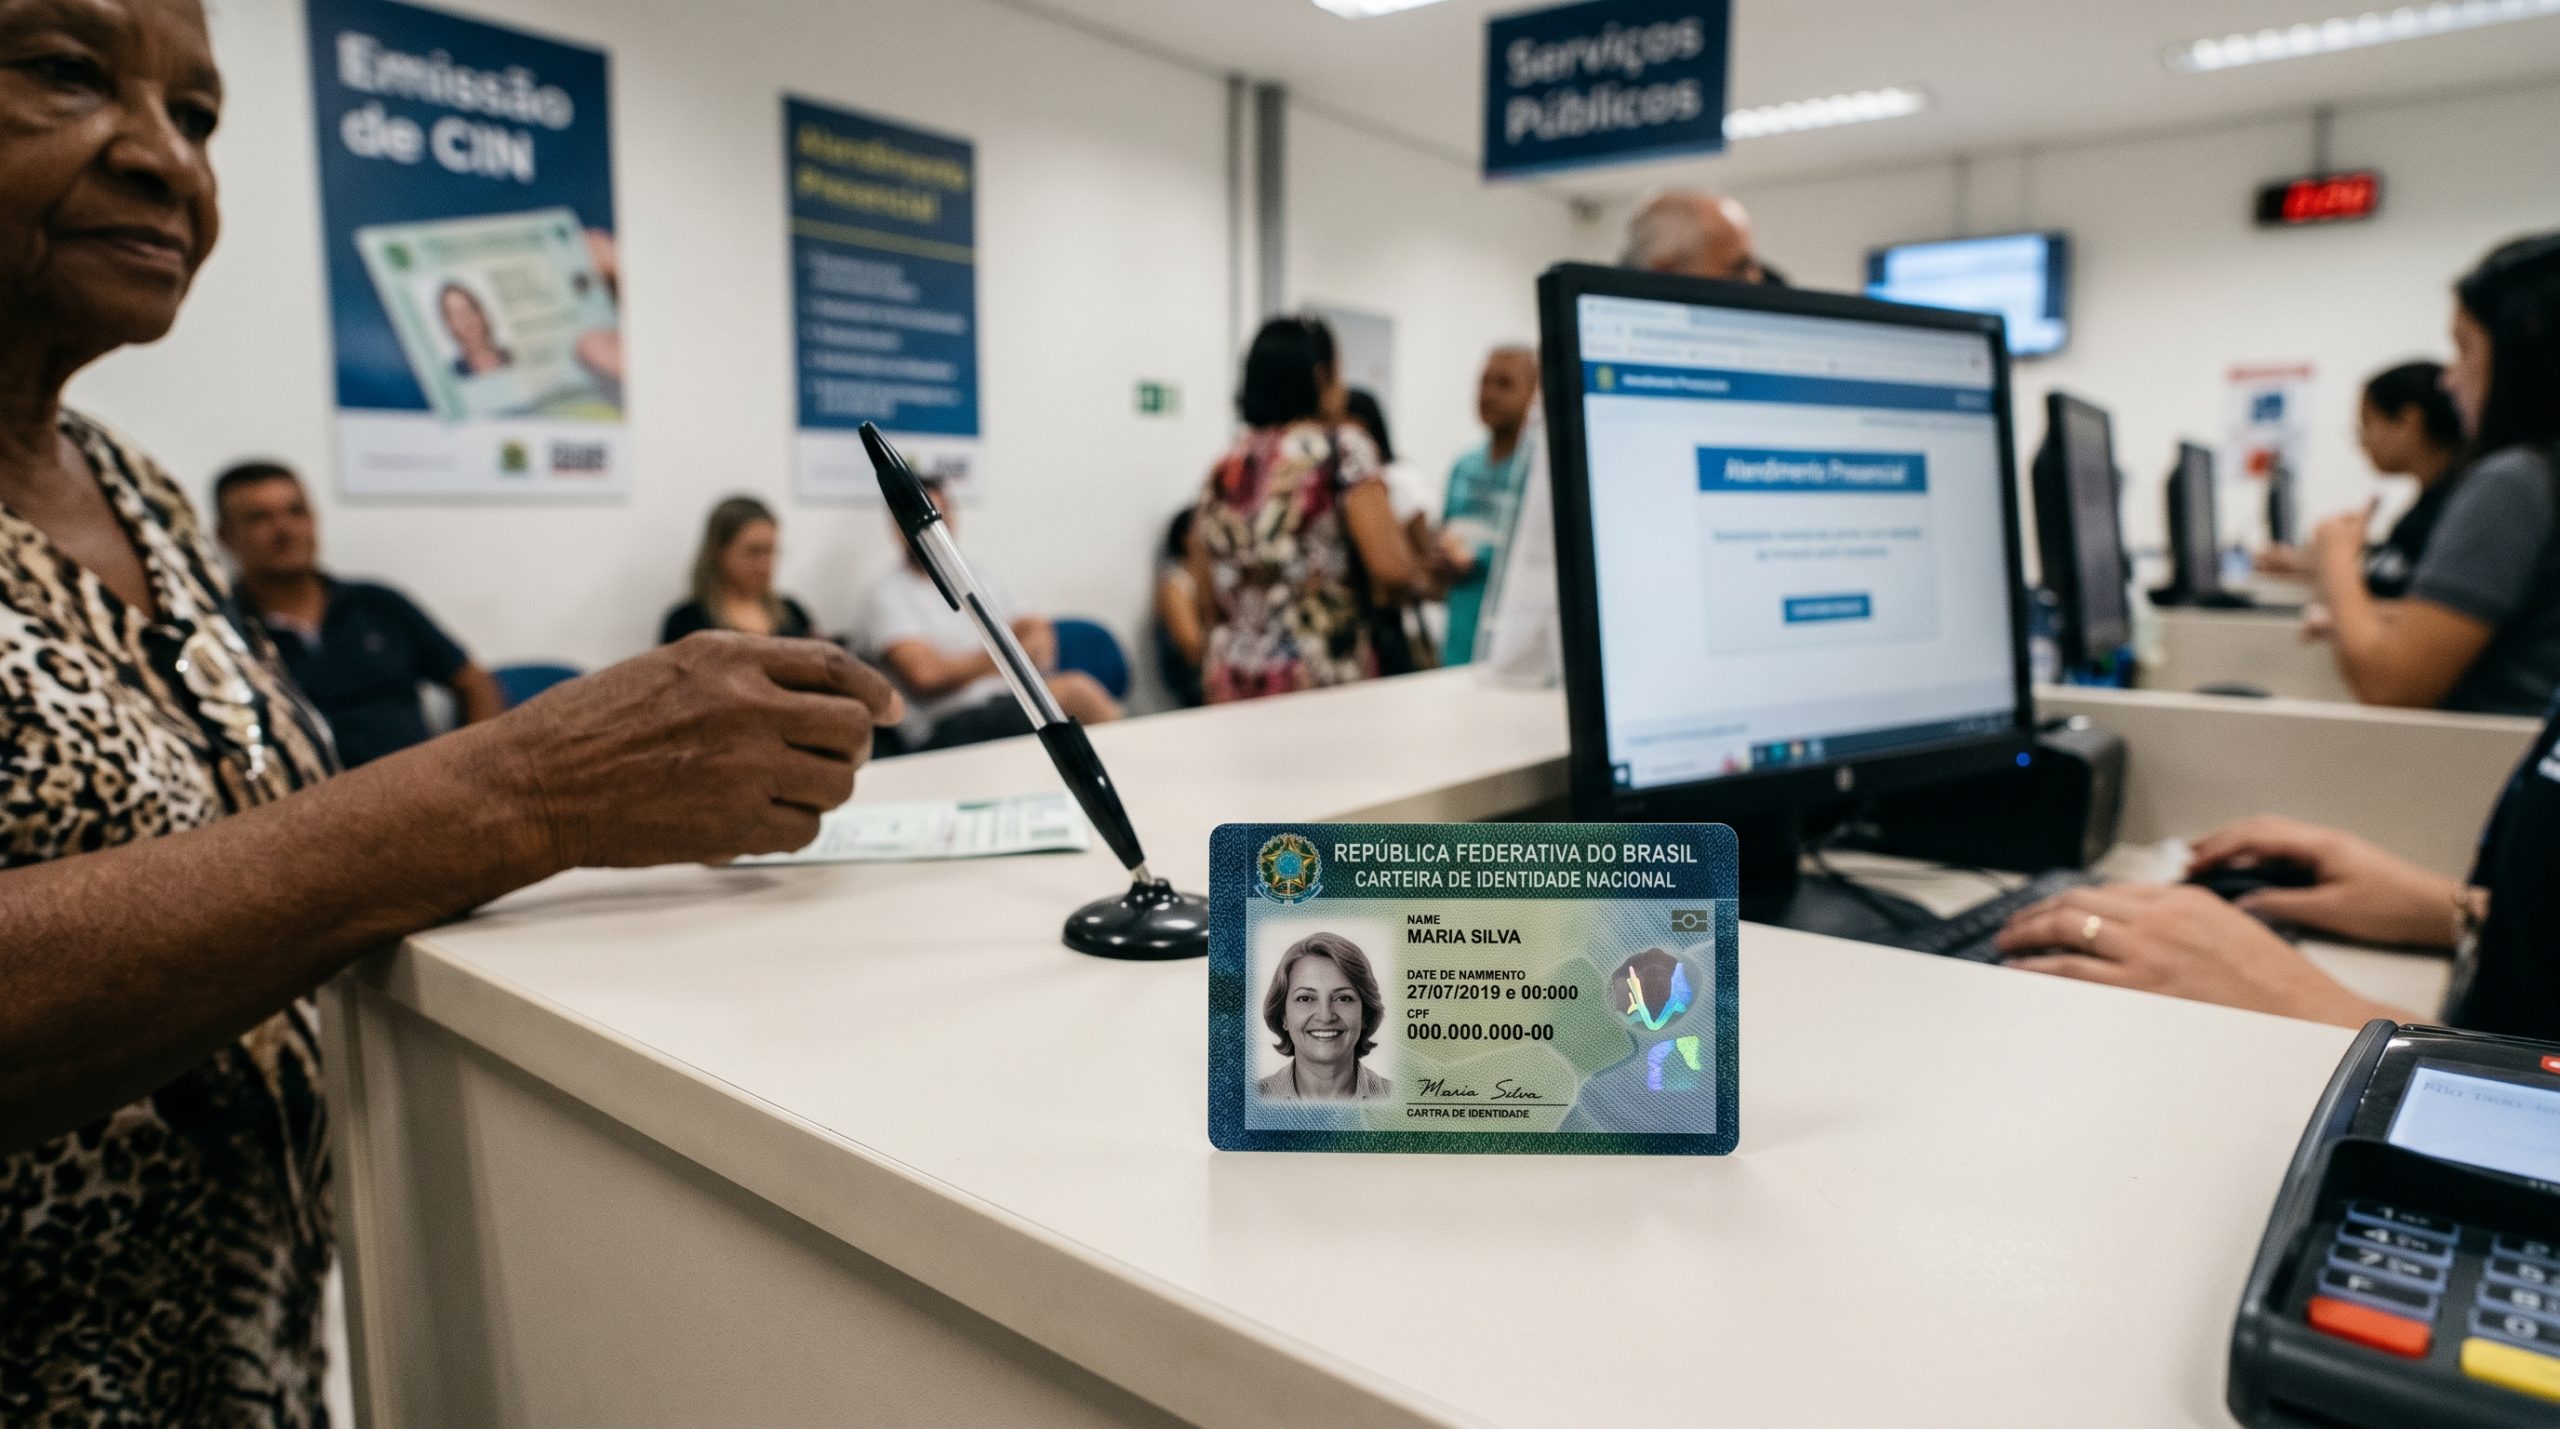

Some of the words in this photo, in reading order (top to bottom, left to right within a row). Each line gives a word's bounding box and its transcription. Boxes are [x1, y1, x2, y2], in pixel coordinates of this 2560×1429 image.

[1507, 18, 1703, 88] Serviços
[337, 31, 574, 130] Emissão
[1506, 80, 1702, 145] Públicos
[340, 101, 425, 165] de
[431, 116, 535, 184] CIN
[1335, 839, 1449, 863] REPÚBLICA
[1457, 844, 1581, 863] FEDERATIVA
[1588, 844, 1616, 863] DO
[1624, 844, 1697, 863] BRASIL
[1355, 871, 1442, 888] CARTEIRA
[1450, 871, 1471, 888] DE
[1477, 871, 1580, 888] IDENTIDADE
[1587, 871, 1676, 889] NACIONAL
[1407, 915, 1440, 924] NAME
[1407, 929, 1466, 944] MARIA
[1471, 929, 1521, 944] SILVA
[1407, 970, 1436, 980] DATE
[1440, 970, 1455, 980] DE
[1459, 970, 1526, 980] NAMMENTO
[1407, 984, 1500, 1000] 27/07/2019
[1506, 988, 1516, 1000] e
[1521, 985, 1578, 1000] 00:000
[1407, 1009, 1430, 1019] CPF
[1407, 1023, 1554, 1040] 000.000.000-00
[1417, 1078, 1479, 1097] Maria
[1490, 1079, 1543, 1100] Silva
[1407, 1108, 1449, 1118] CARTRA
[1452, 1109, 1465, 1118] DE
[1469, 1109, 1530, 1119] IDENTIDADE
[2363, 1228, 2389, 1244] 4
